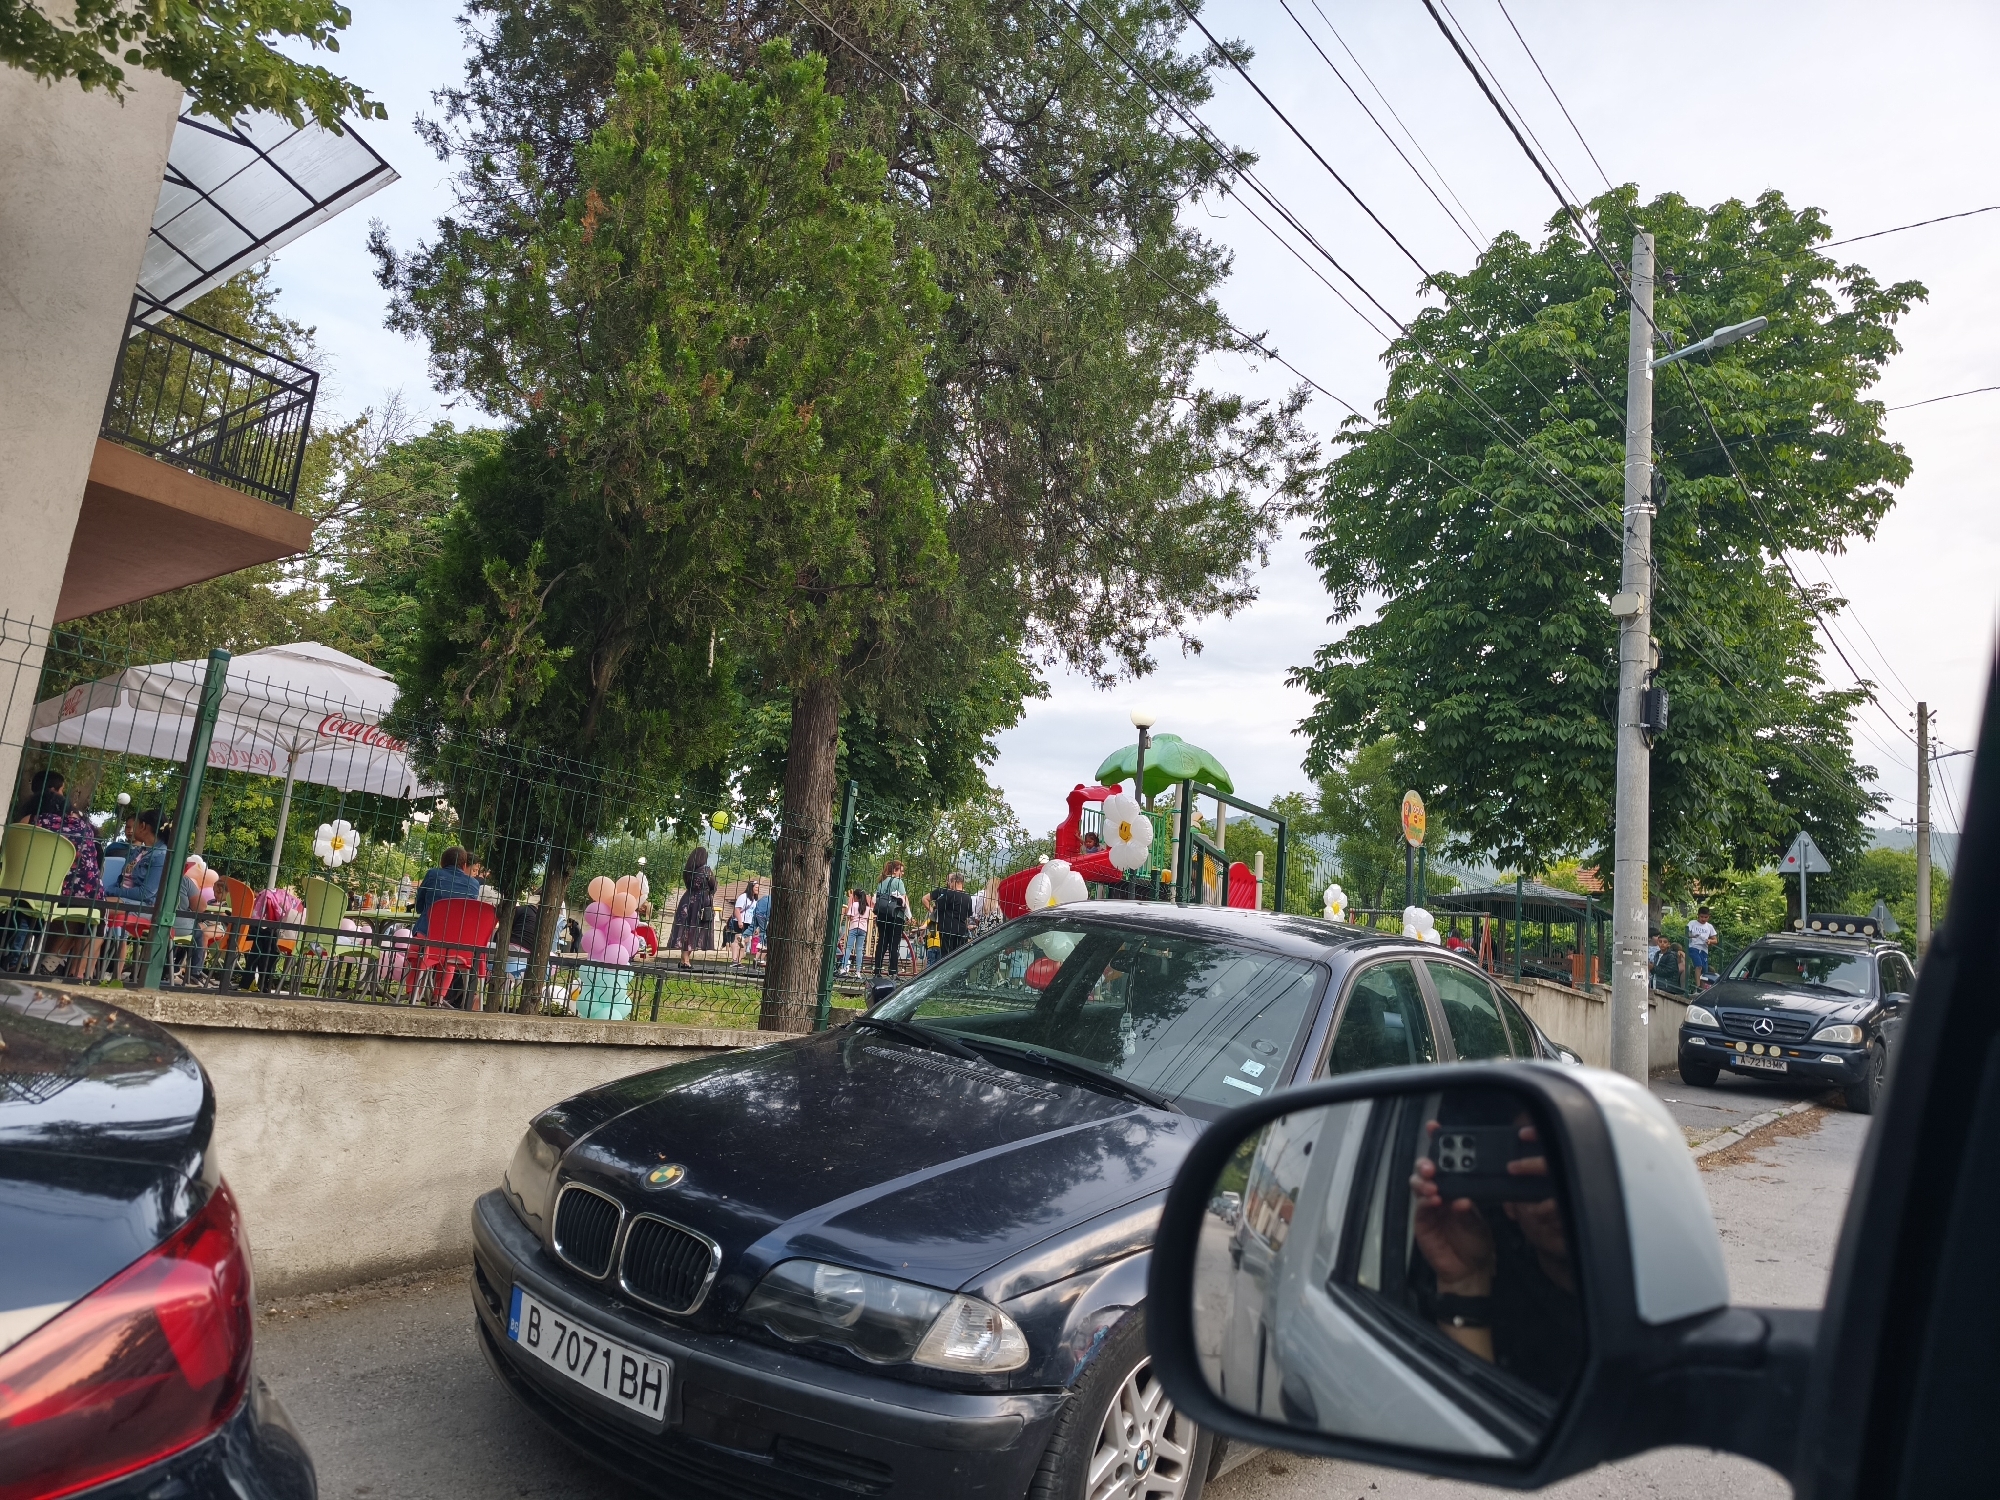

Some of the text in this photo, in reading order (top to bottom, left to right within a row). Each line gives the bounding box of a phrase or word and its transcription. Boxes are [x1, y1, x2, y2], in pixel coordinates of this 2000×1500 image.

[510, 1317, 519, 1333] BG
[527, 1305, 662, 1412] B 7071 BH
